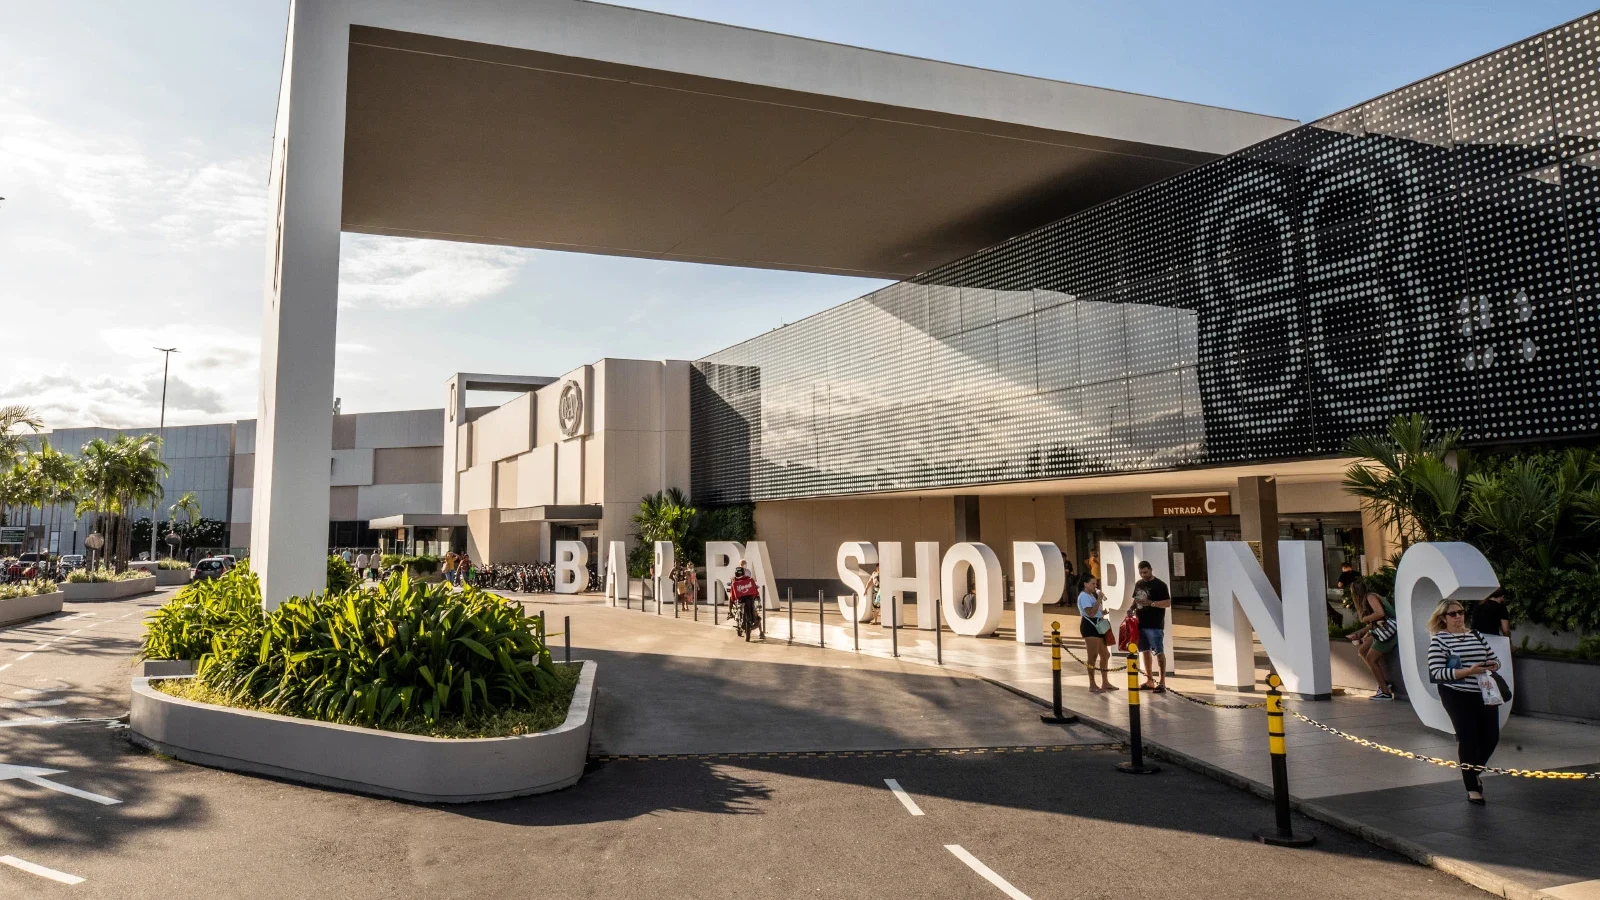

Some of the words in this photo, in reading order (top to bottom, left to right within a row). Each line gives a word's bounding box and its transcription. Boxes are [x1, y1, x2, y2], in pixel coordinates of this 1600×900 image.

[1163, 506, 1203, 515] ENTRADA
[1204, 497, 1217, 514] C
[555, 541, 781, 611] BARRA
[837, 541, 1514, 736] SHOPPING
